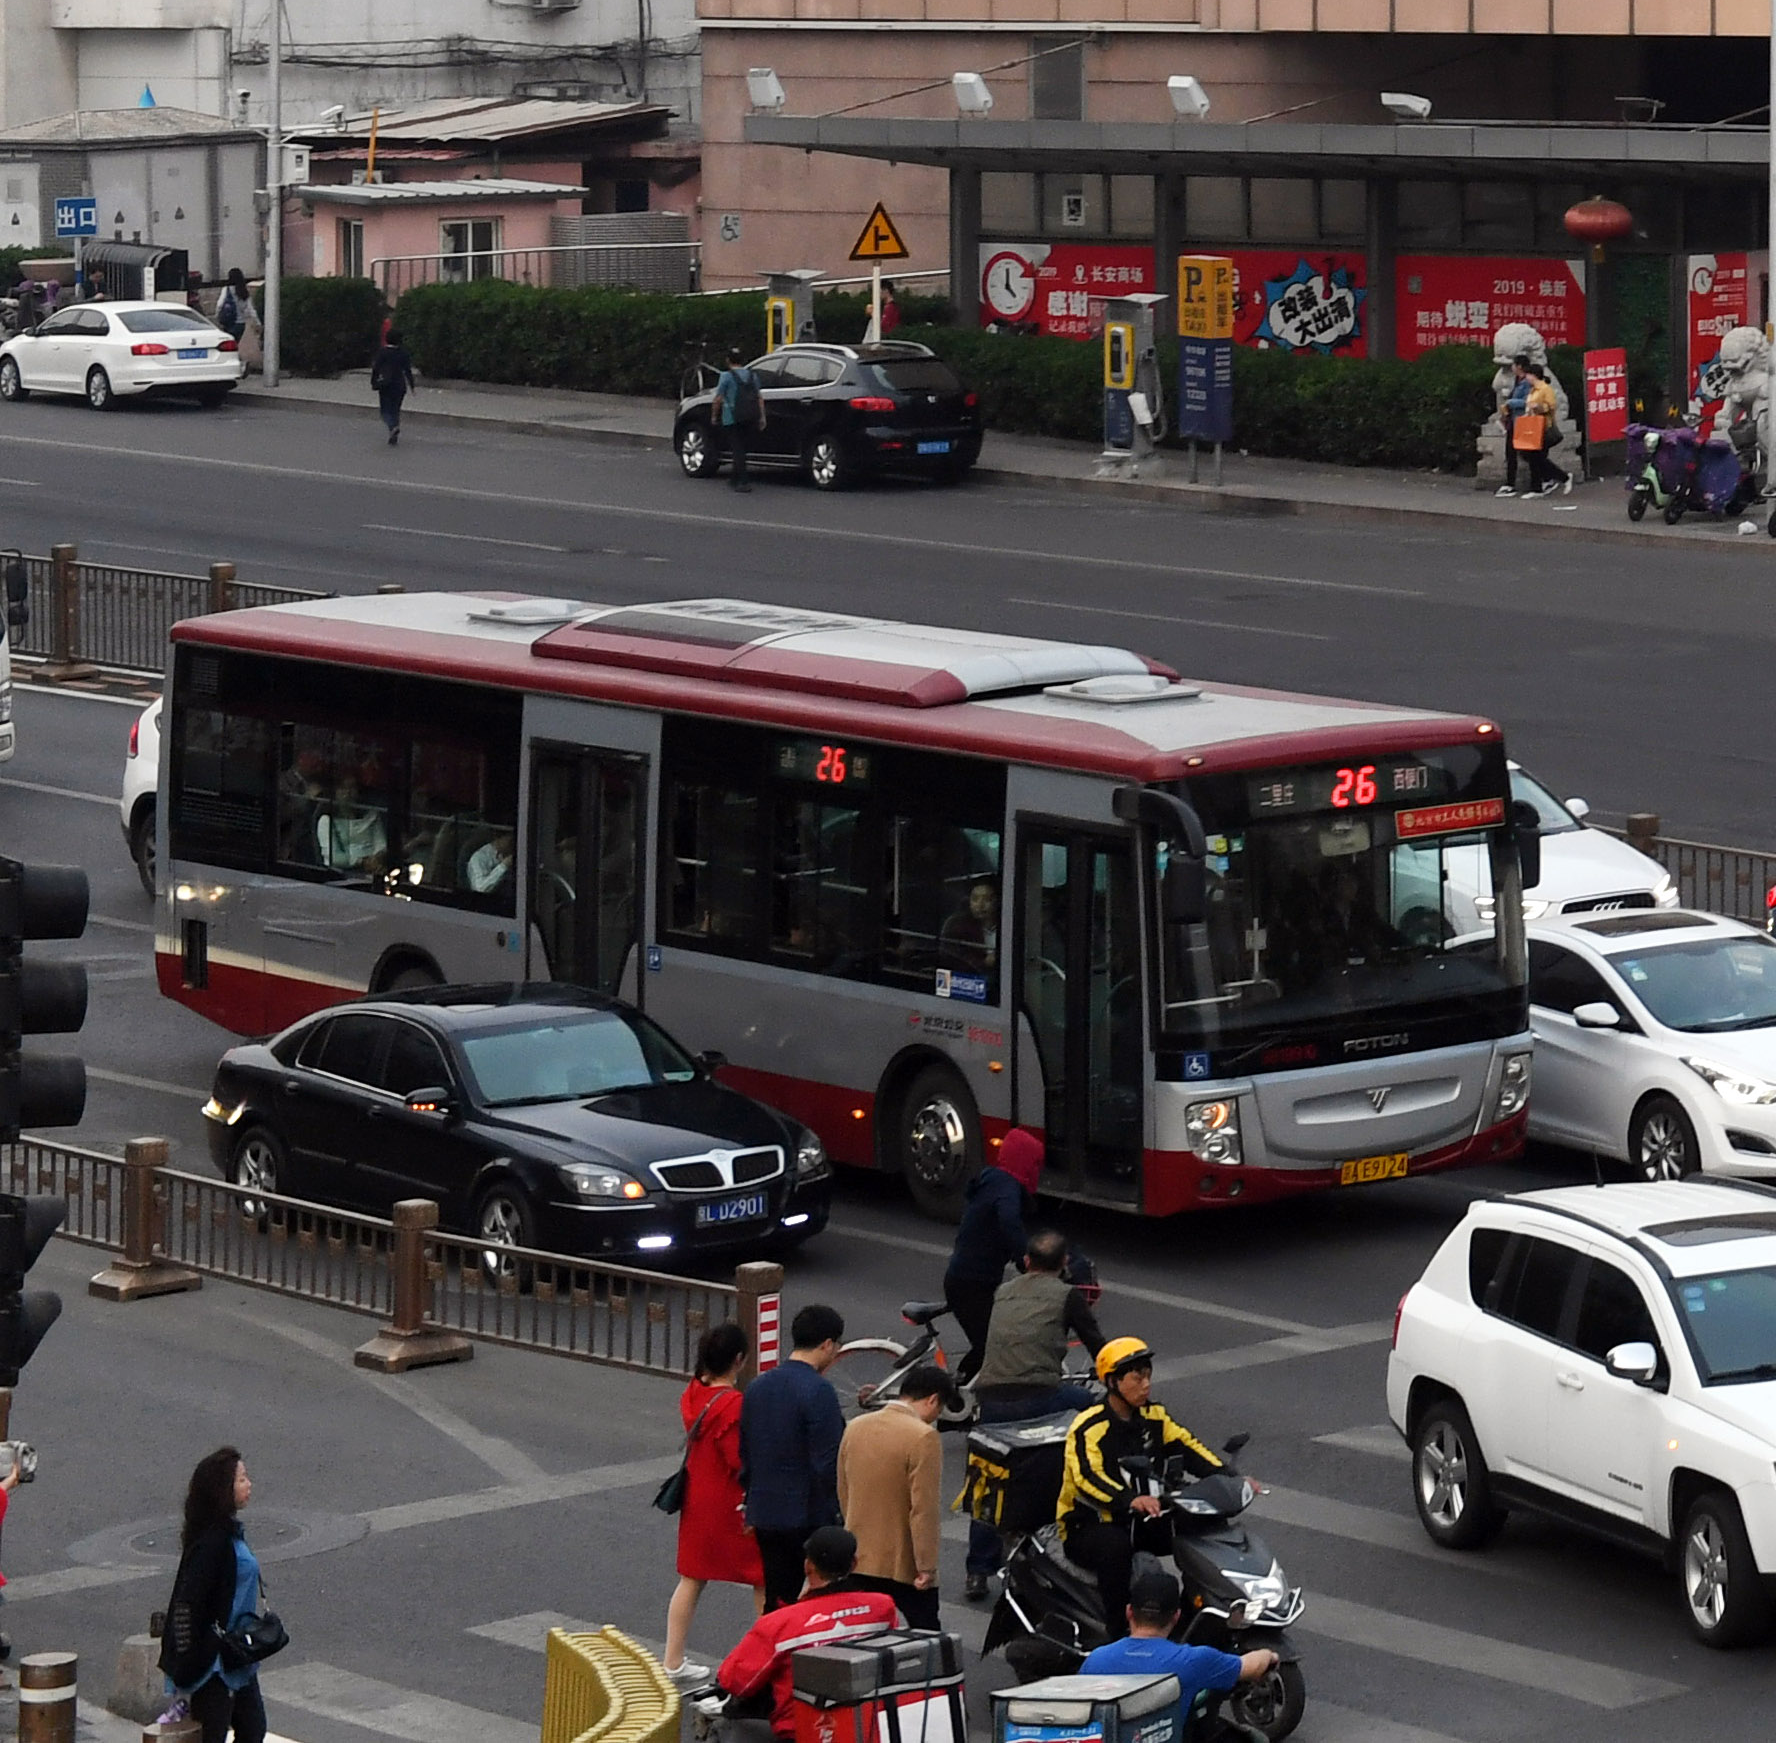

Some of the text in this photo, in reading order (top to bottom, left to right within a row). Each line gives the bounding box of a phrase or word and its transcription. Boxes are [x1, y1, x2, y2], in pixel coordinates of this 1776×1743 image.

[57, 205, 97, 230] 出口
[1090, 265, 1144, 284] 长安商场
[1047, 290, 1088, 318] 感谢
[1278, 285, 1319, 324] 改装
[1416, 311, 1443, 329] 期待
[1445, 299, 1490, 330] 蜕变
[1294, 294, 1351, 345] 大出清
[1588, 397, 1626, 414] 非机动车
[816, 745, 847, 783] 26
[1260, 782, 1296, 807] 二里庄
[1331, 765, 1378, 808] 26
[1343, 1033, 1409, 1053] FOTON
